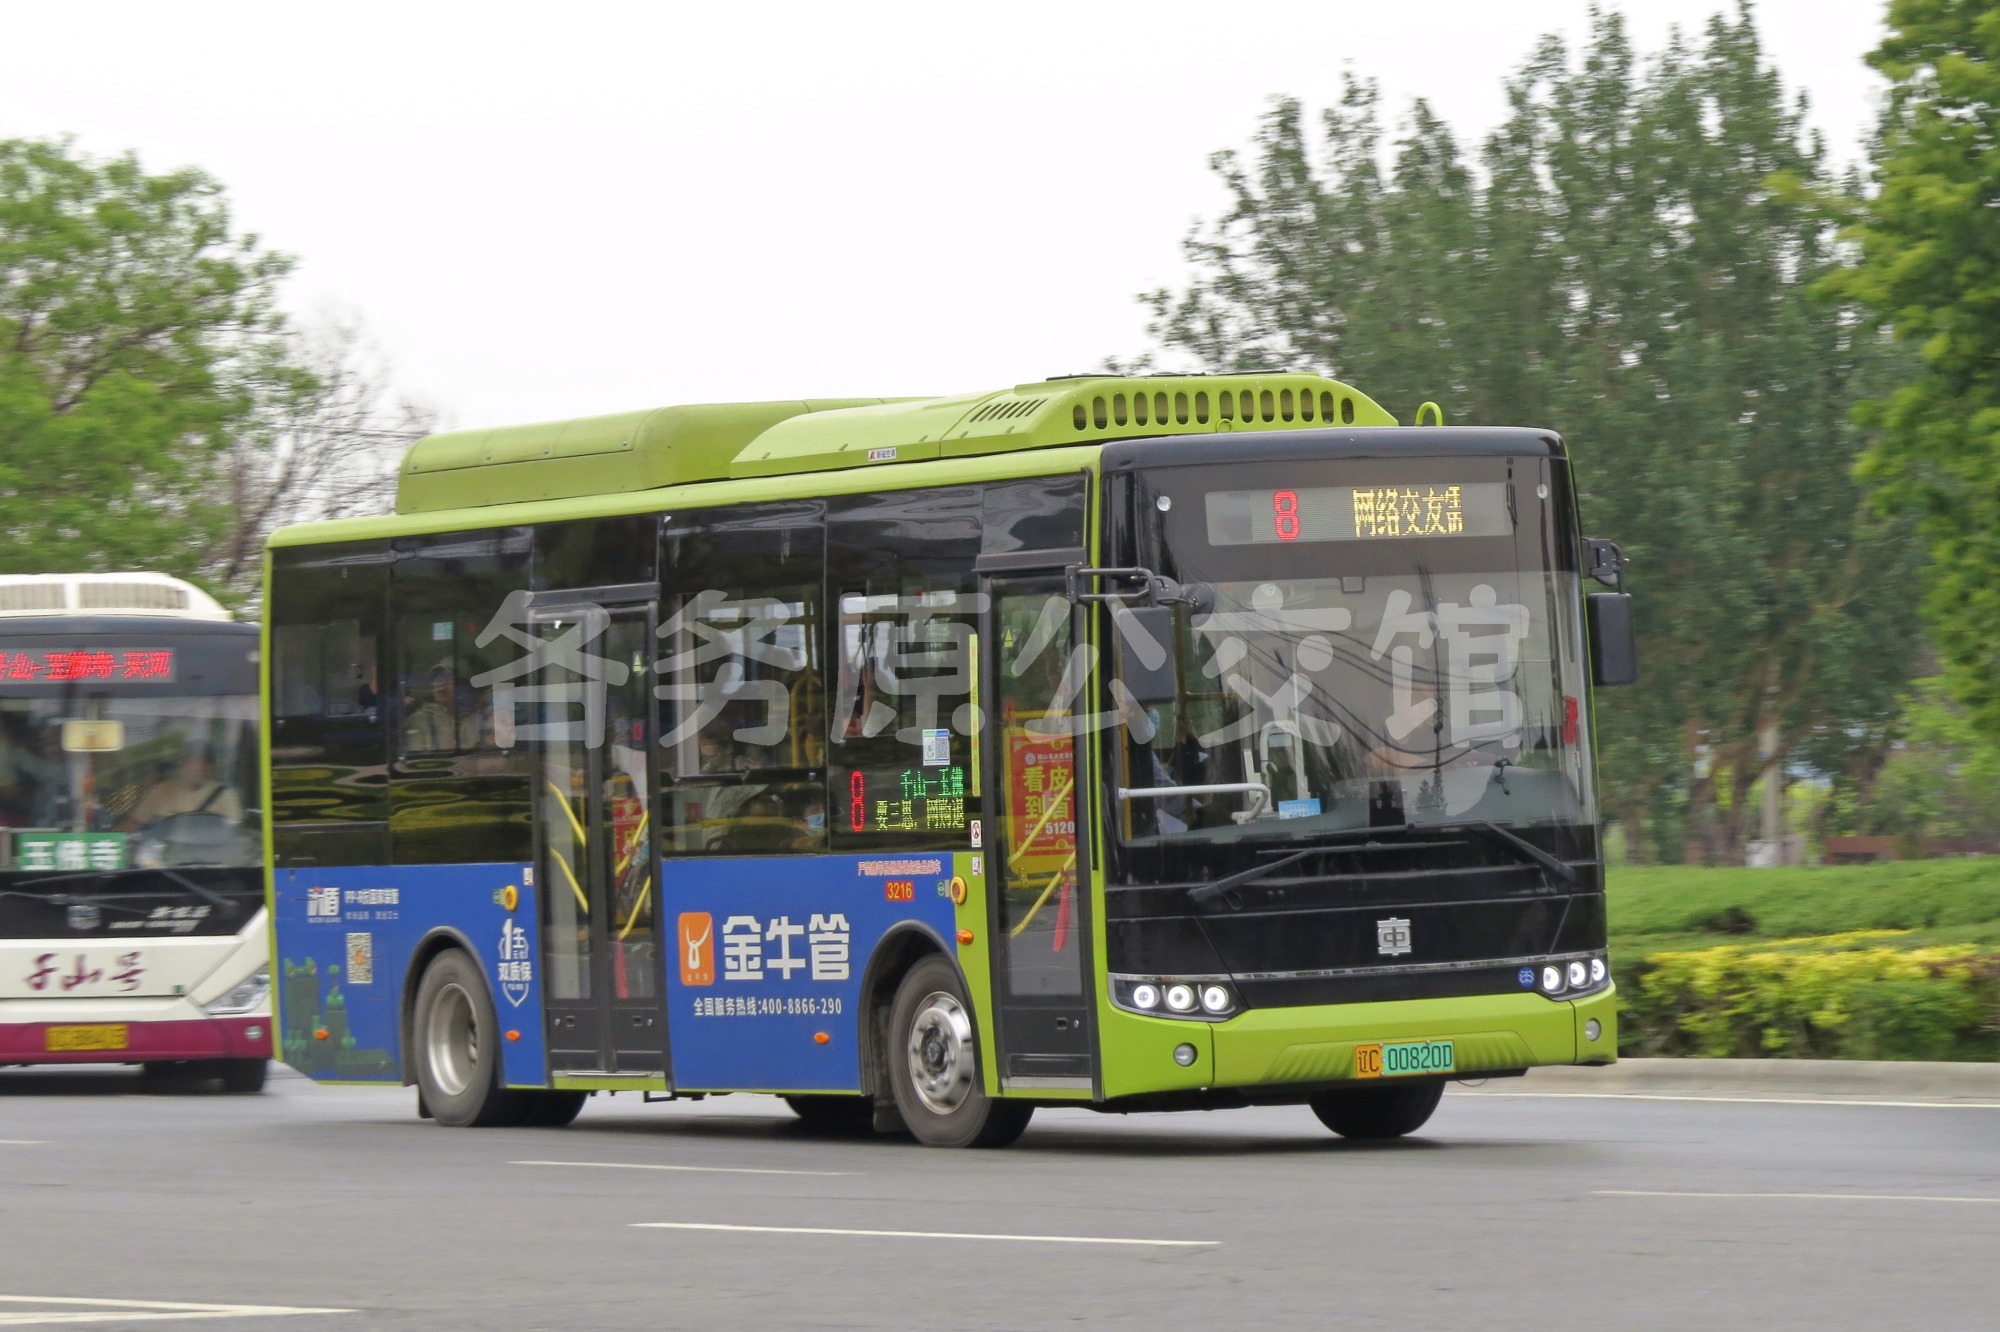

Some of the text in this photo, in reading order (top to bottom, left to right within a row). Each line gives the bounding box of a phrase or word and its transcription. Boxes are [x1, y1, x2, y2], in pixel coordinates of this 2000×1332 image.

[1272, 490, 1300, 541] 8
[850, 771, 864, 831] 8
[1046, 821, 1075, 835] 5120
[22, 839, 122, 871] 玉佛寺
[887, 882, 912, 899] 3216
[722, 913, 850, 980] 金牛管
[694, 997, 842, 1017] 全国服务热线:400-8866-290
[1387, 1044, 1453, 1070] 00820D
